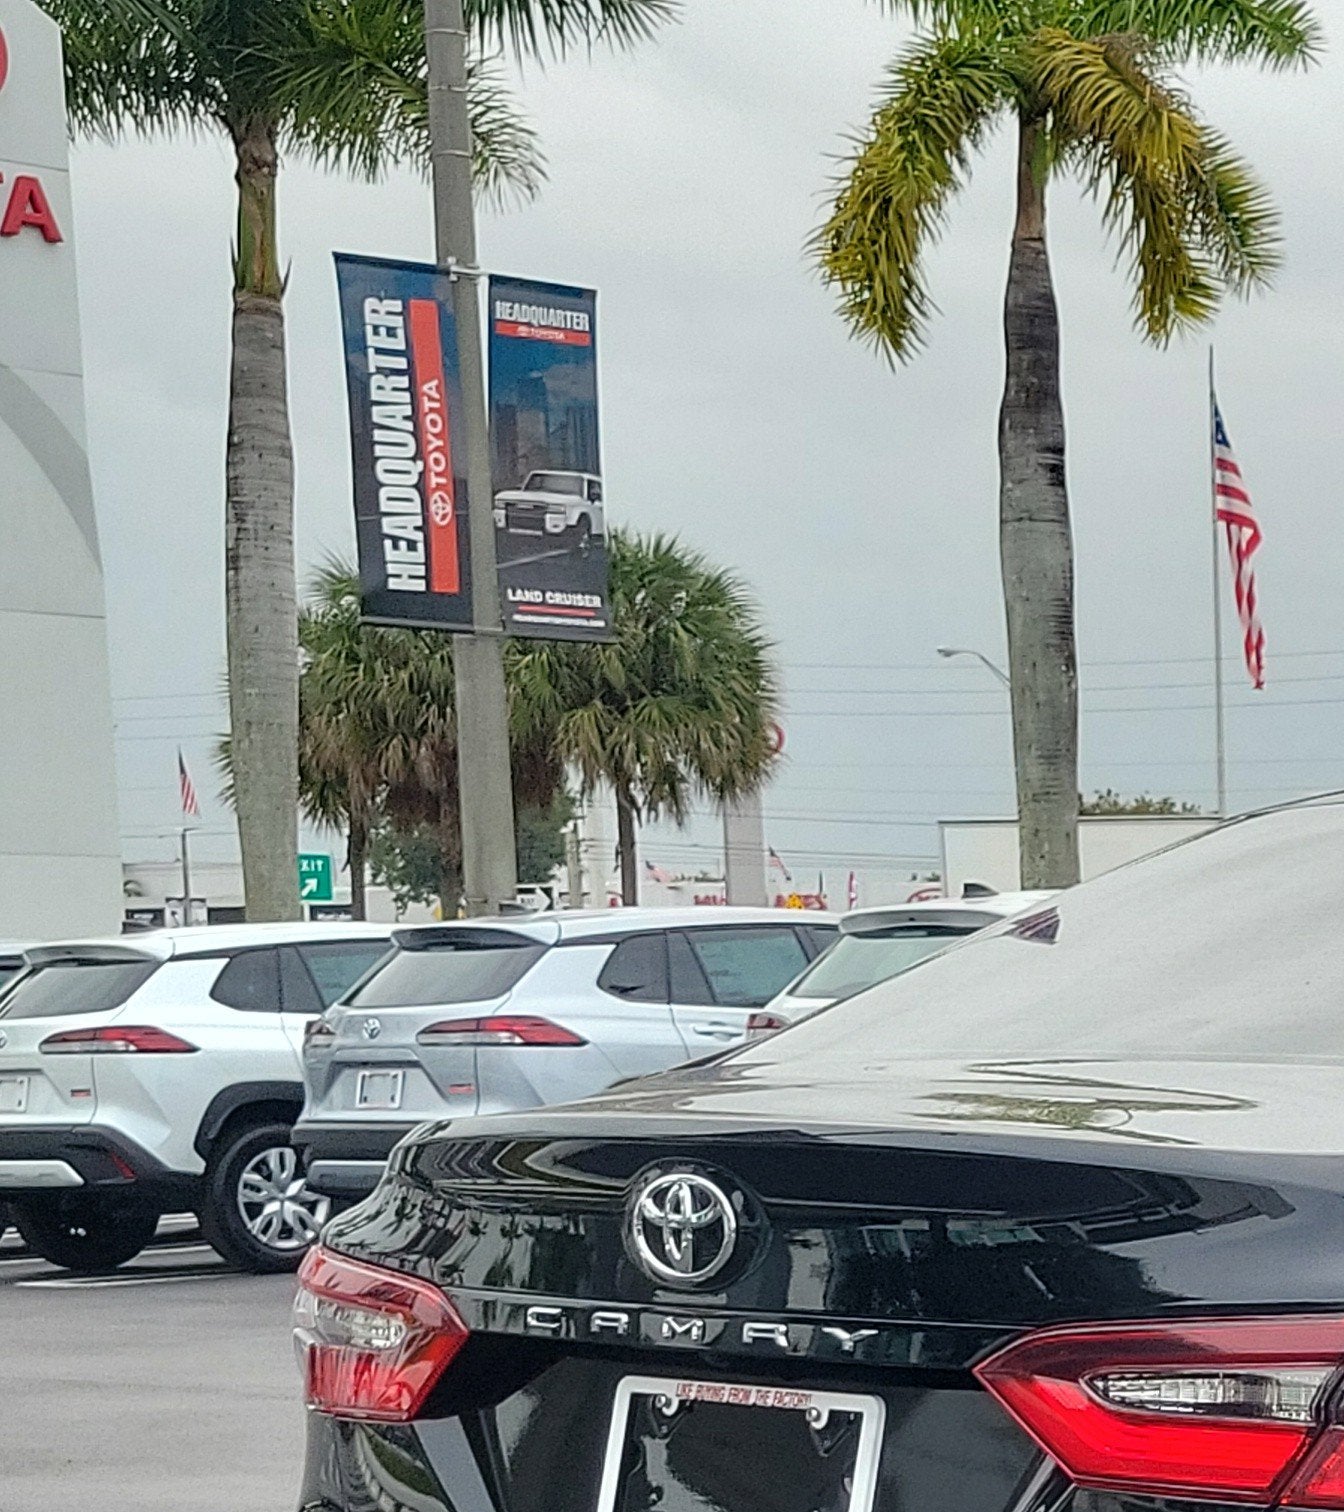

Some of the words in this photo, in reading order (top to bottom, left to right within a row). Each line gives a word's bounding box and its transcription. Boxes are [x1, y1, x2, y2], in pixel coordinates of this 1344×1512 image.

[495, 300, 590, 332] HEADQUARTER
[364, 296, 427, 593] HEADQUARTER
[422, 378, 449, 488] TOYOTA
[507, 587, 543, 603] LAND
[545, 590, 602, 608] CRUISER
[526, 1305, 880, 1352] CAMRY
